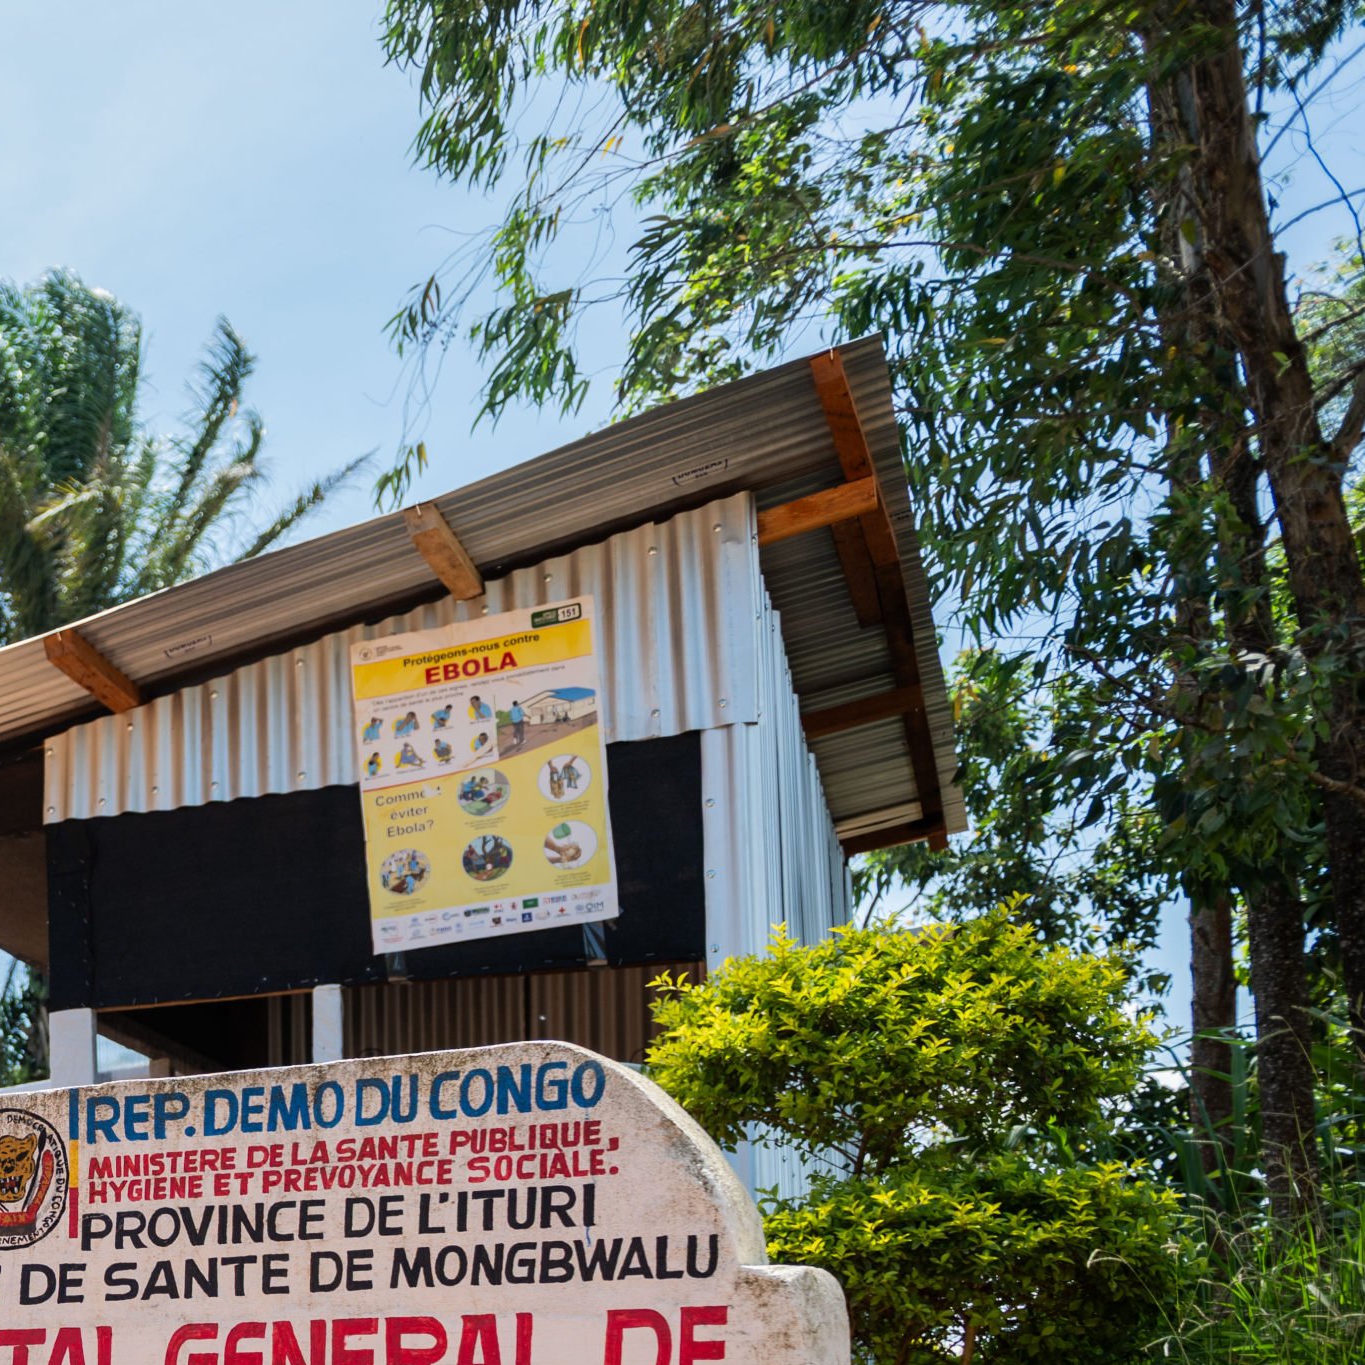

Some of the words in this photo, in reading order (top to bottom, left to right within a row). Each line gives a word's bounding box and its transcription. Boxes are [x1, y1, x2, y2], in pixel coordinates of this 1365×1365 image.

[561, 607, 577, 618] 151
[403, 640, 501, 668] Protégeons-nous
[503, 633, 540, 648] contre
[425, 651, 518, 685] EBOLA
[387, 819, 434, 838] Ebola?
[204, 1080, 345, 1137] DEMO
[355, 1072, 420, 1127] DU
[428, 1060, 606, 1119] CONGO
[88, 1147, 236, 1180] MINISTERE
[246, 1143, 284, 1169] DE
[290, 1140, 331, 1166] LA
[336, 1131, 440, 1163] SANTE
[448, 1120, 620, 1156] PUBLIQUE,
[88, 1175, 213, 1204] HYGIENE
[214, 1171, 257, 1197] ET
[267, 1158, 453, 1193] PREVOYANCE
[467, 1148, 619, 1183] SOCIALE.
[42, 1195, 63, 1228] CONGO
[81, 1199, 325, 1251] PROVINCE
[343, 1194, 404, 1239] DE
[420, 1183, 596, 1235] L'ITURI
[19, 1261, 87, 1306] DE
[105, 1254, 291, 1303] SANTE
[309, 1247, 374, 1292] DE
[390, 1234, 720, 1289] MONGBWALU
